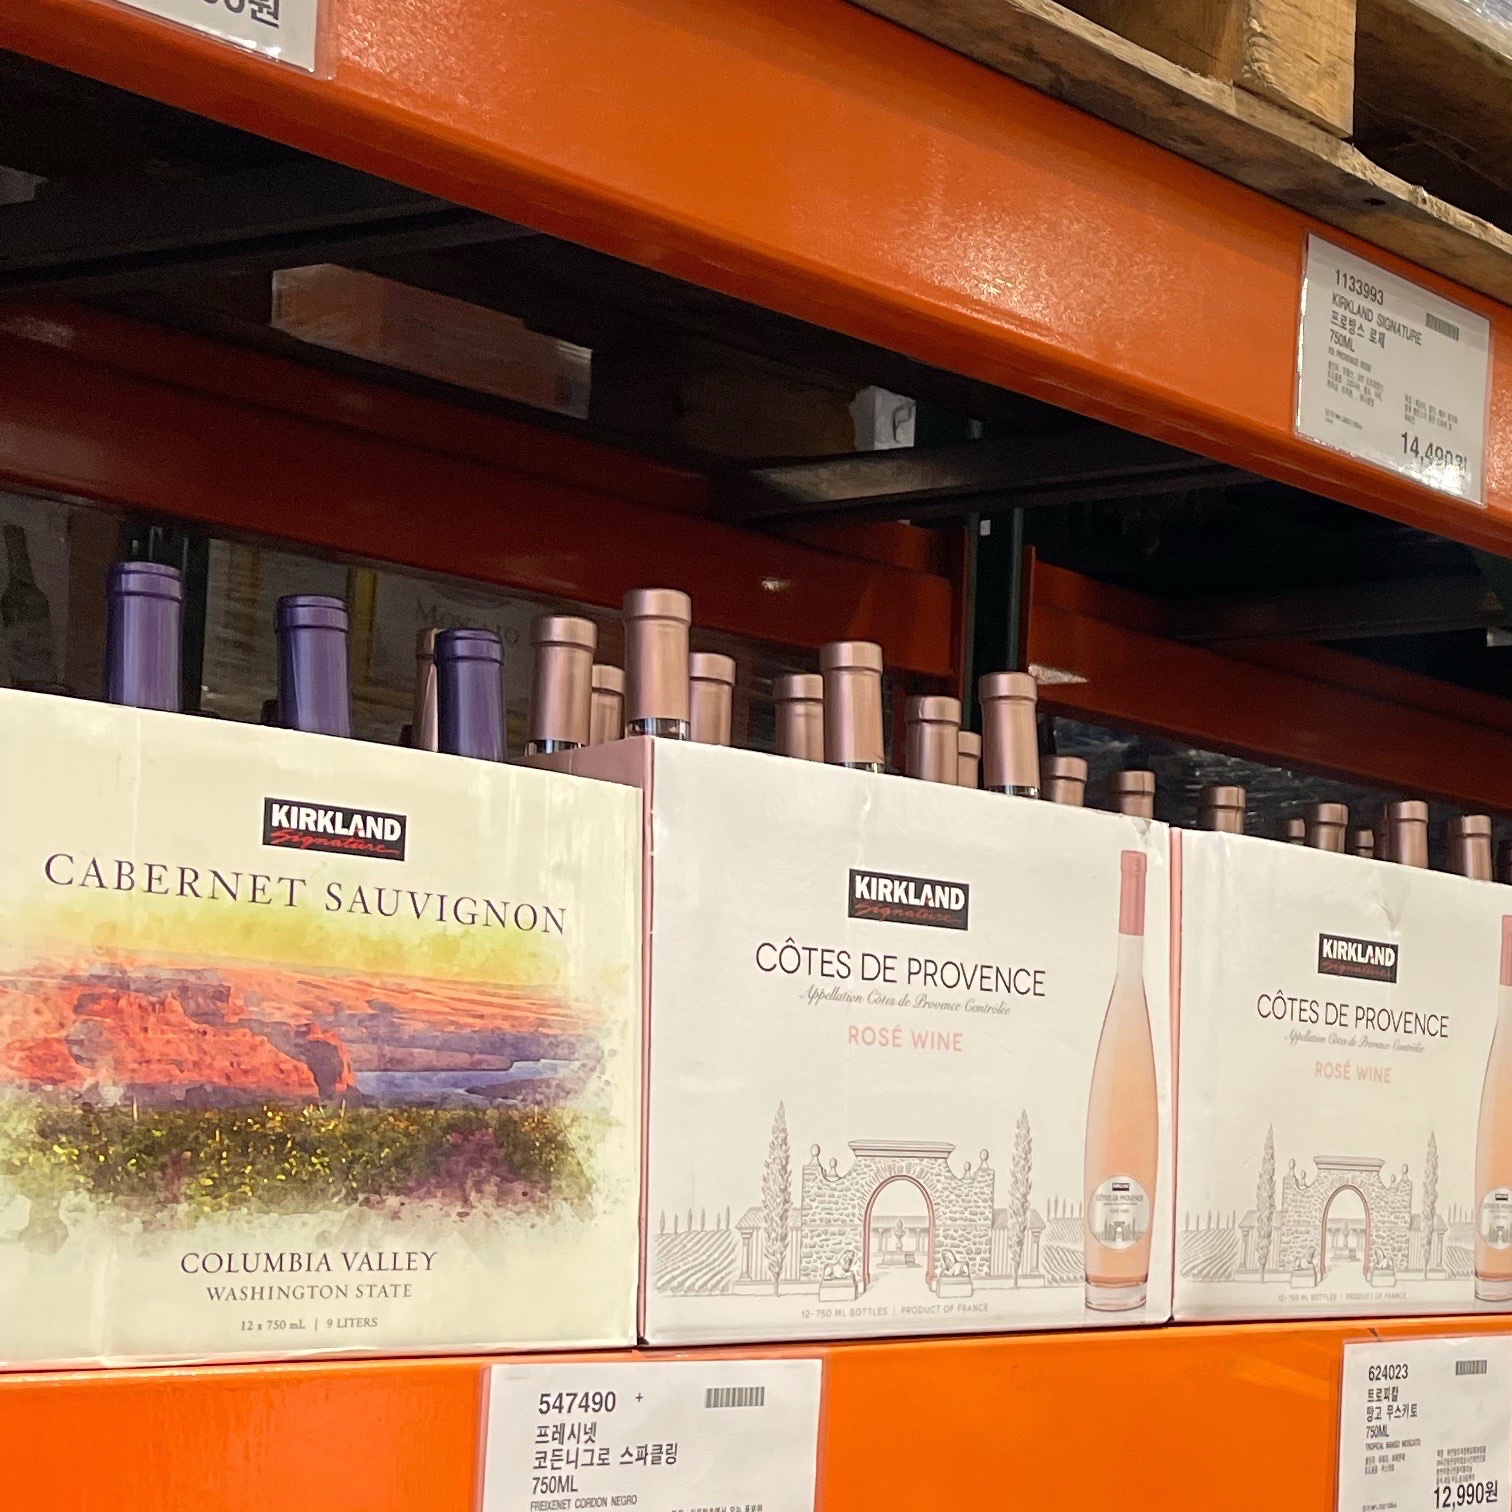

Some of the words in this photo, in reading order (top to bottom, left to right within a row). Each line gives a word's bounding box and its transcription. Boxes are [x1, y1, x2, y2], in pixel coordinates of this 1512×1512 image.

[1334, 269, 1384, 305] 1133993
[1331, 292, 1374, 322] KIRKLAND
[1376, 314, 1422, 347] SIGNATURE
[1329, 329, 1355, 352] 750ML
[271, 803, 401, 841] KIRKLAND
[43, 852, 306, 908] CABERNET
[325, 882, 567, 936] SAUVIGNON
[855, 874, 965, 911] KIRKLAND
[1323, 938, 1395, 967] KIRKLAND
[756, 936, 851, 980] CÔTES
[861, 953, 897, 983] DE
[907, 957, 1046, 997] PROVENCE
[1257, 989, 1319, 1024] CÔTES
[1325, 1002, 1349, 1027] DE
[1355, 1005, 1449, 1038] PROVENCE
[848, 1024, 902, 1048] ROSÉ
[911, 1028, 963, 1052] WINE
[1315, 1061, 1350, 1081] ROSÉ
[1356, 1065, 1391, 1084] WINE
[181, 1251, 333, 1274] COLUMBIA
[341, 1251, 439, 1271] VALLEY
[206, 1284, 349, 1301] WASHINGTON
[355, 1283, 412, 1299] STATE
[850, 1306, 888, 1317] BOTTLES
[901, 1305, 941, 1315] PRODUCT
[943, 1304, 954, 1313] OF
[957, 1303, 989, 1312] FRANCE
[240, 1320, 254, 1331] 12
[266, 1319, 286, 1331] 750
[326, 1318, 333, 1329] 9
[336, 1317, 378, 1329] LITERS
[1368, 1363, 1409, 1381] 624023
[538, 1391, 617, 1415] 547490
[1366, 1406, 1382, 1423] 망고
[534, 1421, 597, 1445] 프레시넷
[1366, 1424, 1390, 1439] 750ML
[619, 1443, 679, 1466] 스파클링
[532, 1475, 579, 1494] 750ML
[1433, 1480, 1498, 1512] 12,990원
[574, 1497, 608, 1509] CORDON
[611, 1495, 638, 1506] NEGRO
